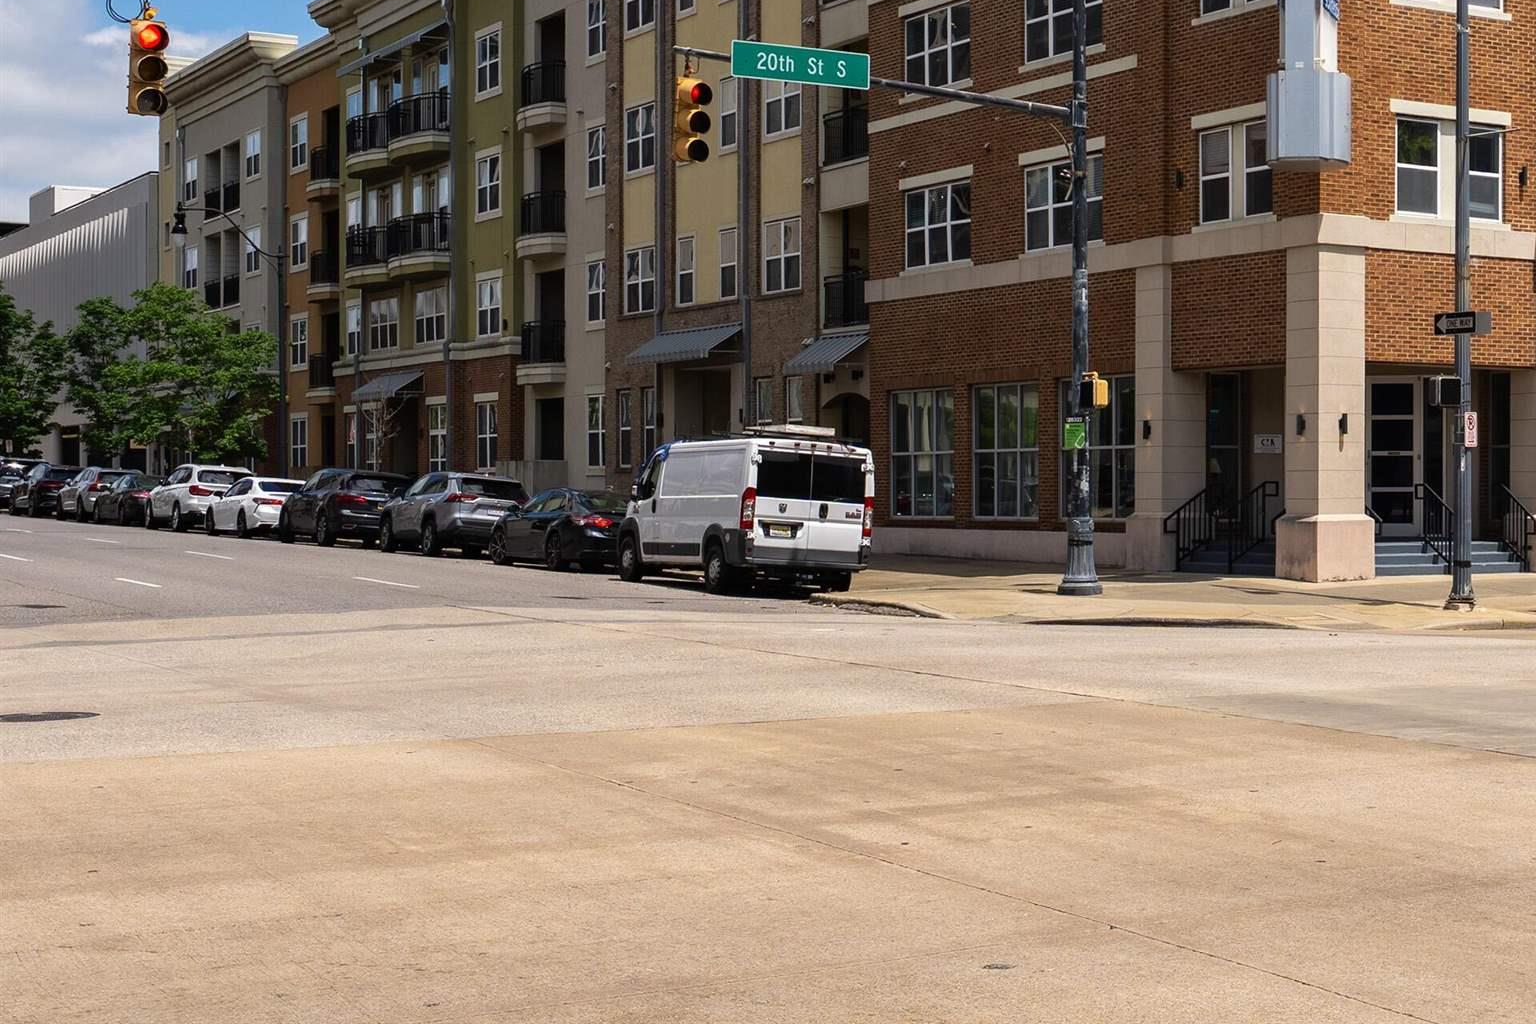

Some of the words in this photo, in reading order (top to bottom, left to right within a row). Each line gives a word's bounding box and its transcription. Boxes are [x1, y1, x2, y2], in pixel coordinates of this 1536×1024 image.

[756, 52, 795, 73] 20th
[807, 57, 824, 76] St
[836, 60, 847, 78] S
[1446, 319, 1458, 328] ONE
[1460, 318, 1472, 327] WAY
